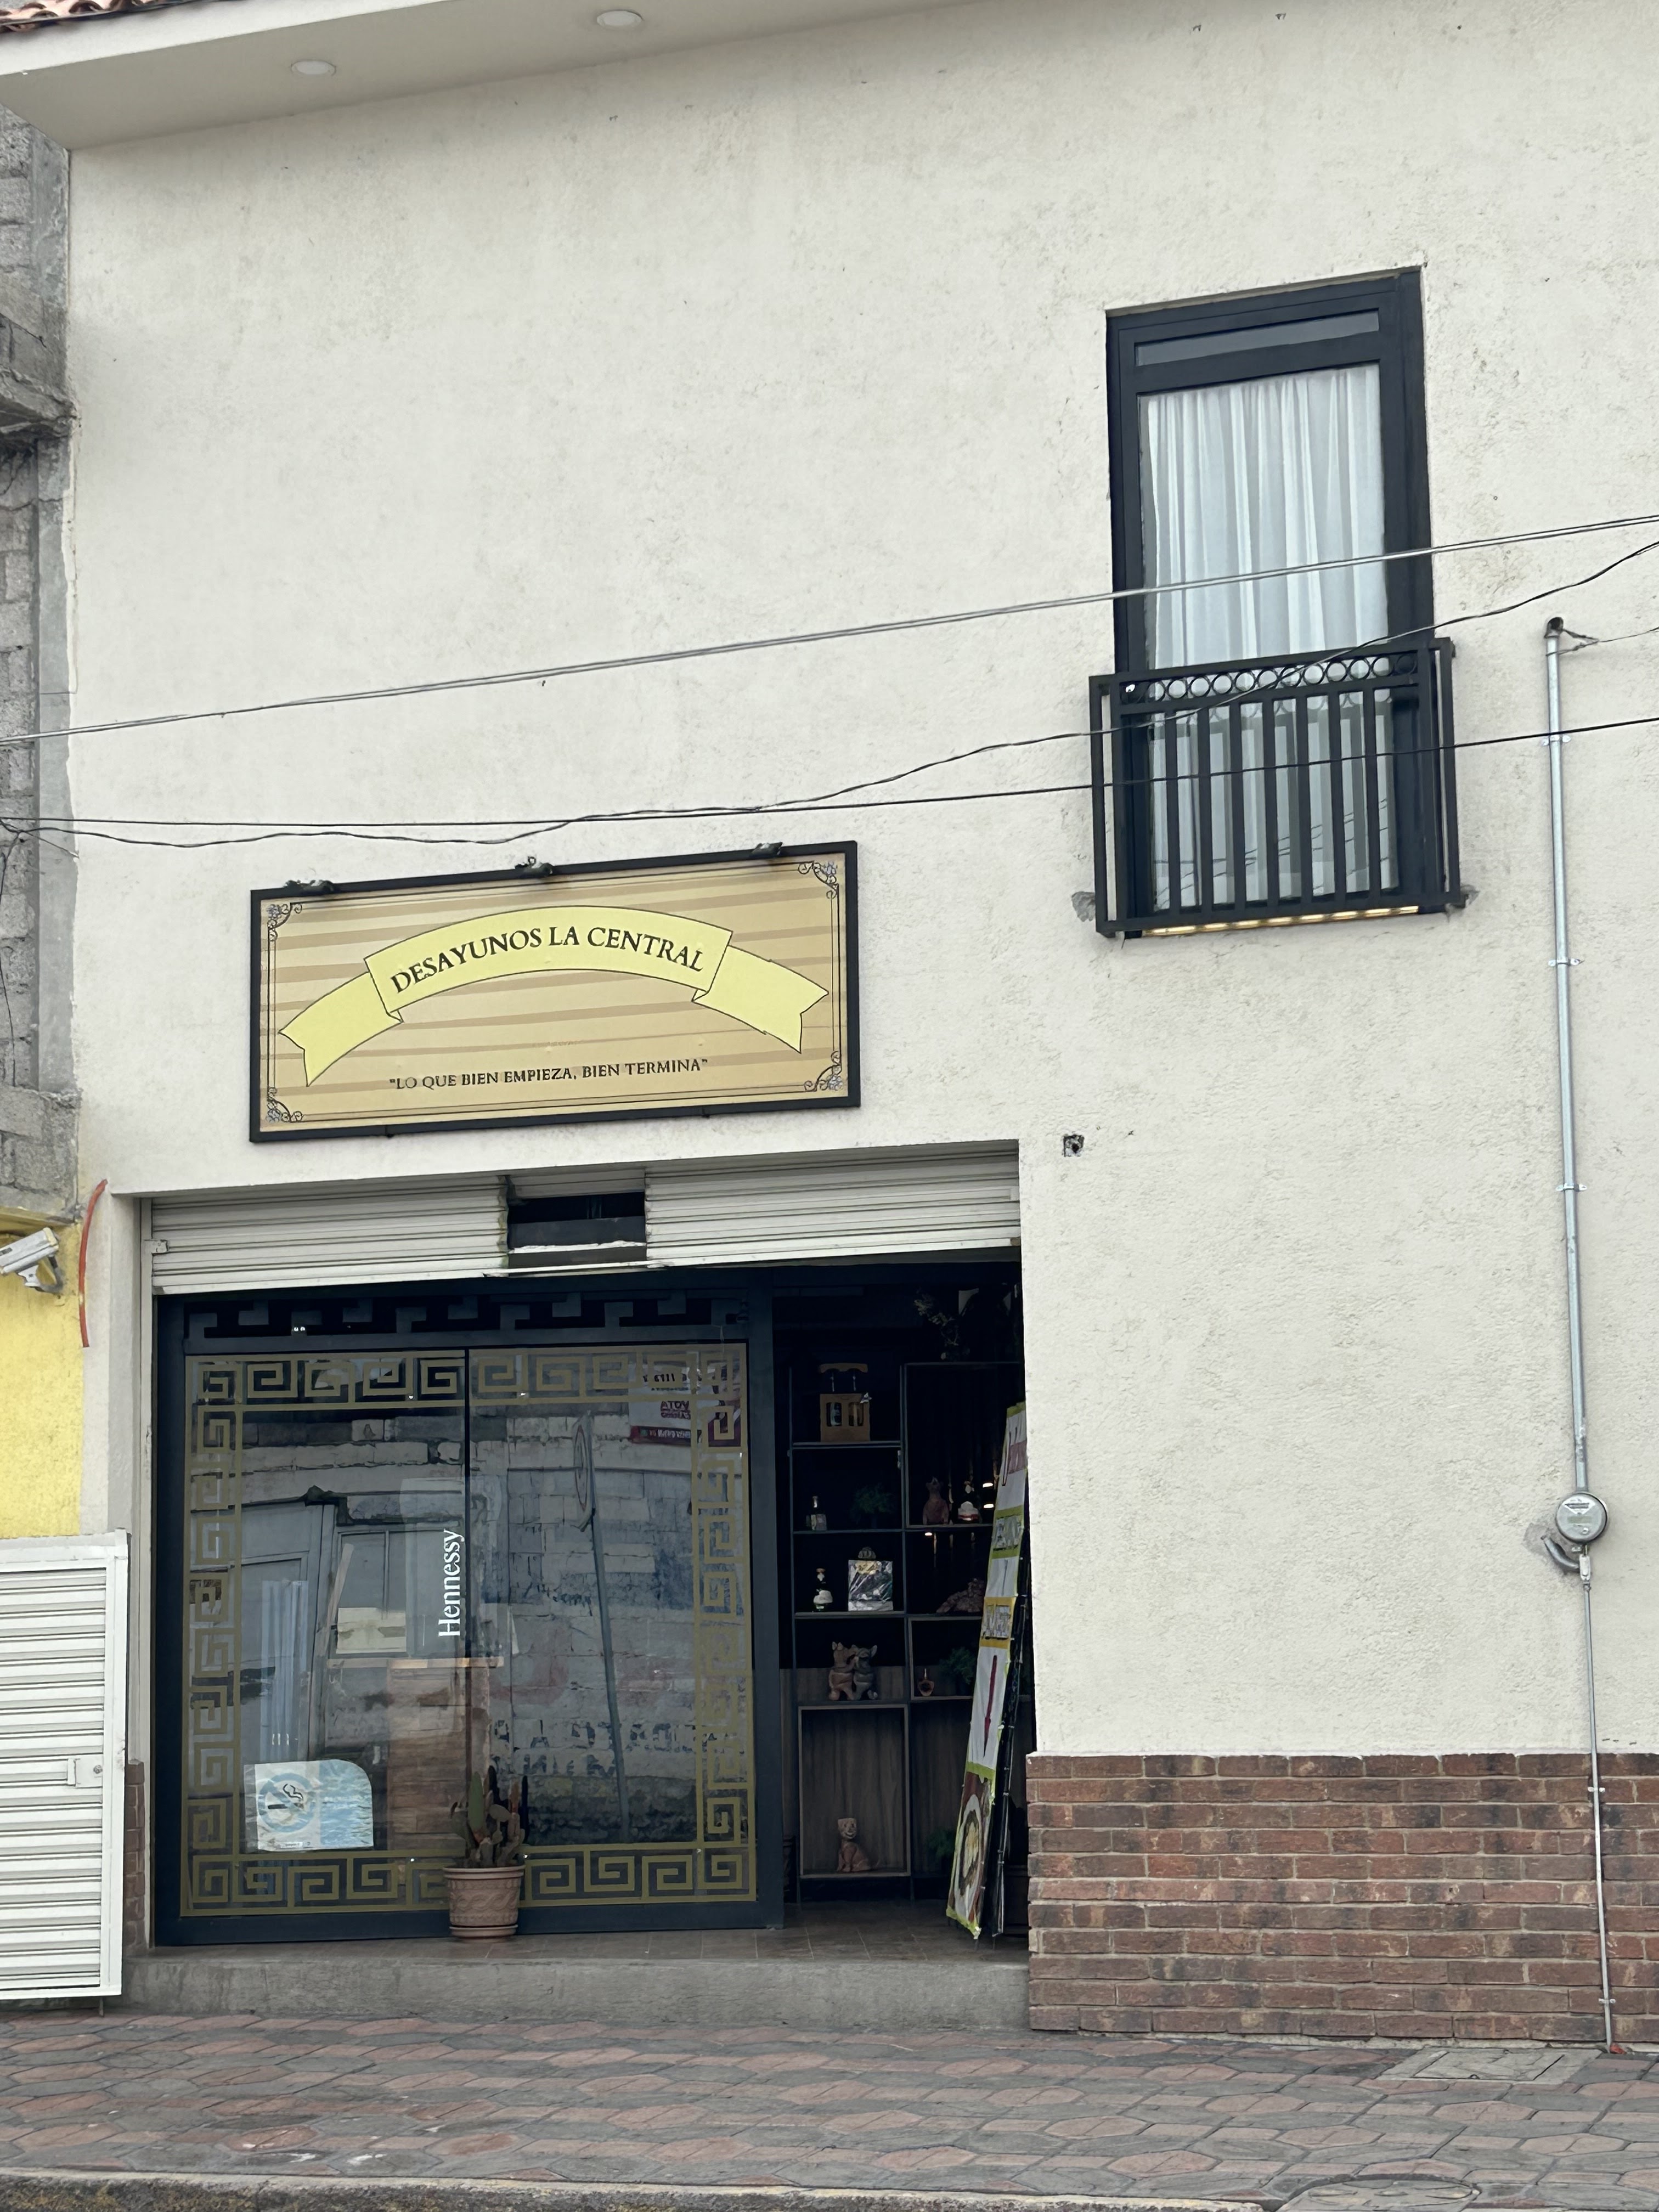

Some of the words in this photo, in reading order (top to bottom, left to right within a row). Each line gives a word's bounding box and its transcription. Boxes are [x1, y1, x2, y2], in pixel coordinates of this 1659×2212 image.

[390, 928, 542, 994] DESAYUNOS
[549, 926, 580, 946] LA
[587, 927, 703, 972] CENTRAL
[422, 1075, 457, 1091] QUE
[461, 1071, 499, 1086] BIEN
[504, 1068, 577, 1084] EMPIEZA,
[582, 1064, 620, 1079] BIEN
[438, 1528, 465, 1637] Hennessy
